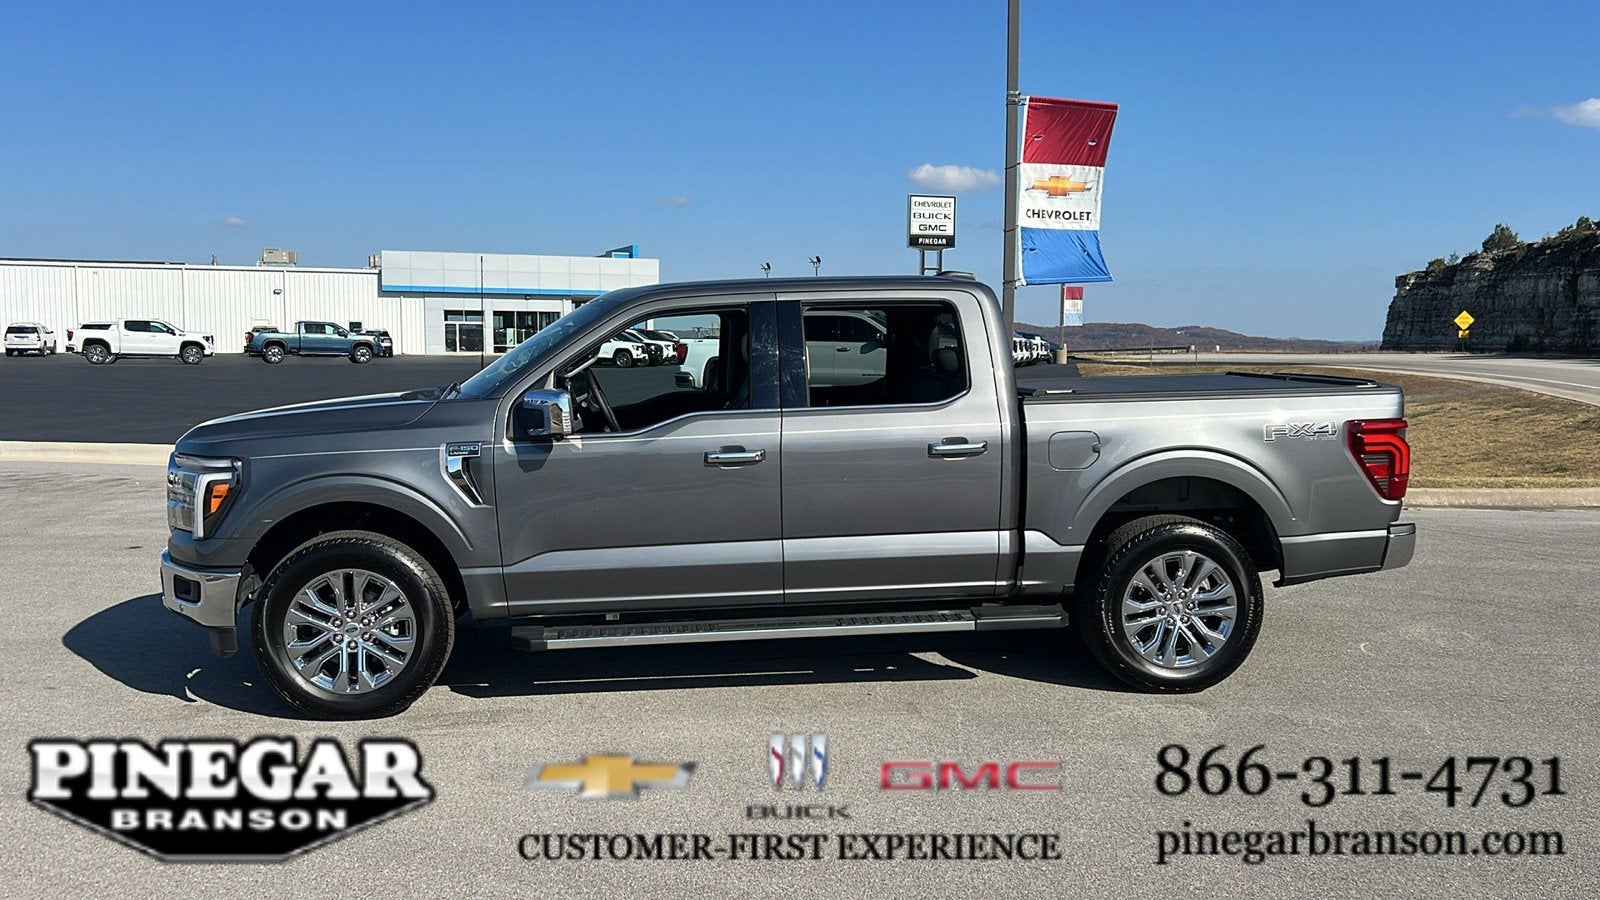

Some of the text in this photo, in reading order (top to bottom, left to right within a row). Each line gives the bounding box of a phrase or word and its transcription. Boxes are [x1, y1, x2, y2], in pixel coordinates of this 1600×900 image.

[913, 200, 952, 208] CHEVROLET
[913, 212, 952, 220] BUICK
[1026, 208, 1092, 221] CHEVROLET
[918, 223, 947, 232] GMC
[918, 237, 947, 245] PINEGAR
[1264, 421, 1337, 442] FX4
